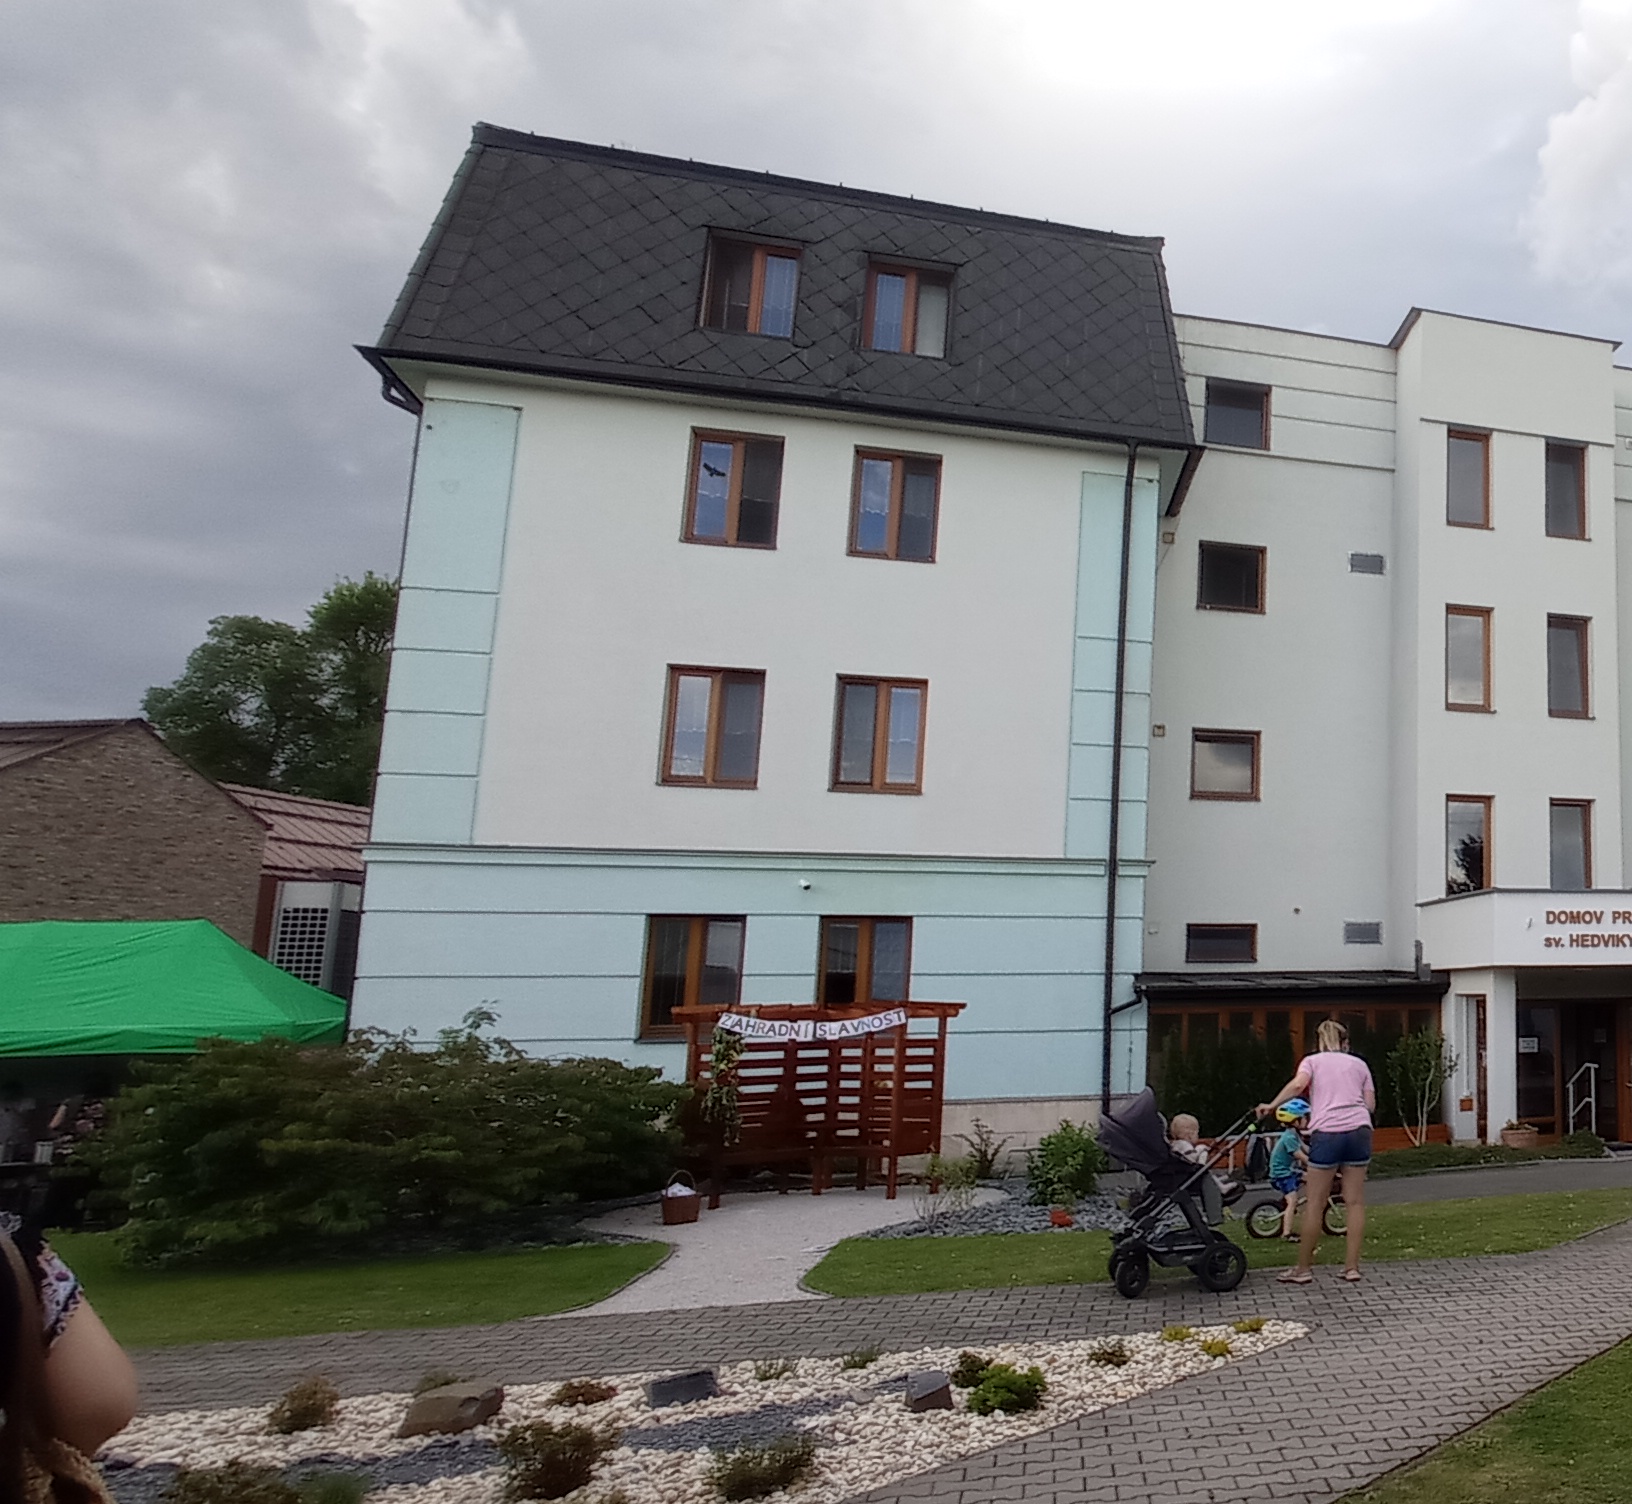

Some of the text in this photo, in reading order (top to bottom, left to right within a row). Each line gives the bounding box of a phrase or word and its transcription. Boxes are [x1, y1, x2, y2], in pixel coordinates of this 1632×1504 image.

[1545, 910, 1604, 925] DOMOV
[1543, 936, 1565, 948] sv.
[817, 1009, 904, 1037] SLAVNOST
